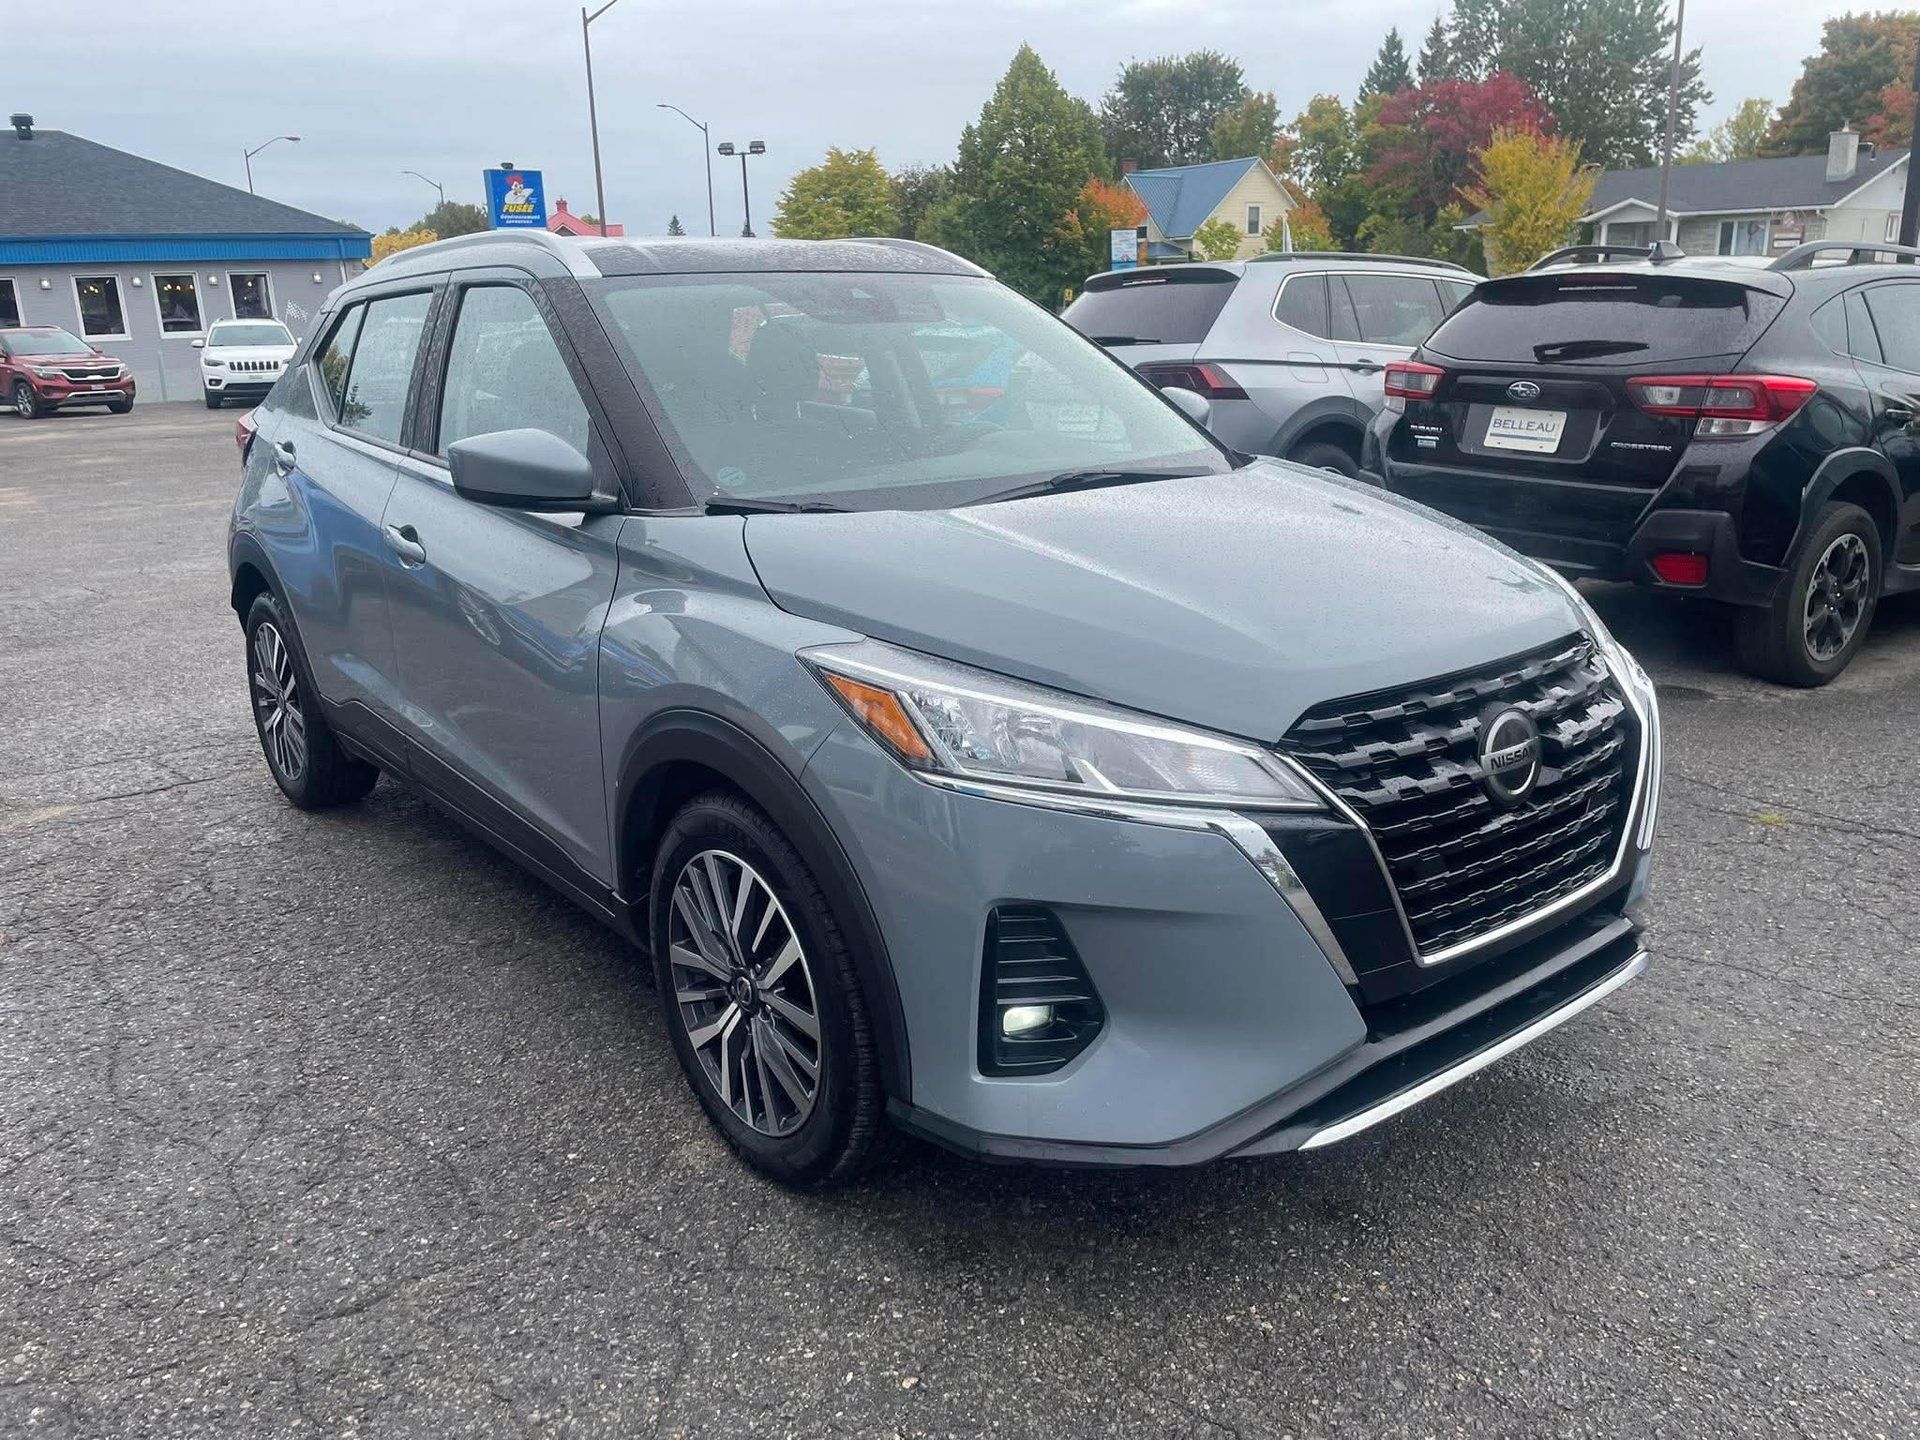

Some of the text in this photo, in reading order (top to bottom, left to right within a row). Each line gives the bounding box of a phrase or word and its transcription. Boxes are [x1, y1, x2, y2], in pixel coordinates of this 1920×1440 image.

[1410, 424, 1443, 433] SUBARU
[1493, 418, 1555, 432] BELLEAU
[1610, 442, 1672, 452] CROSSTREK
